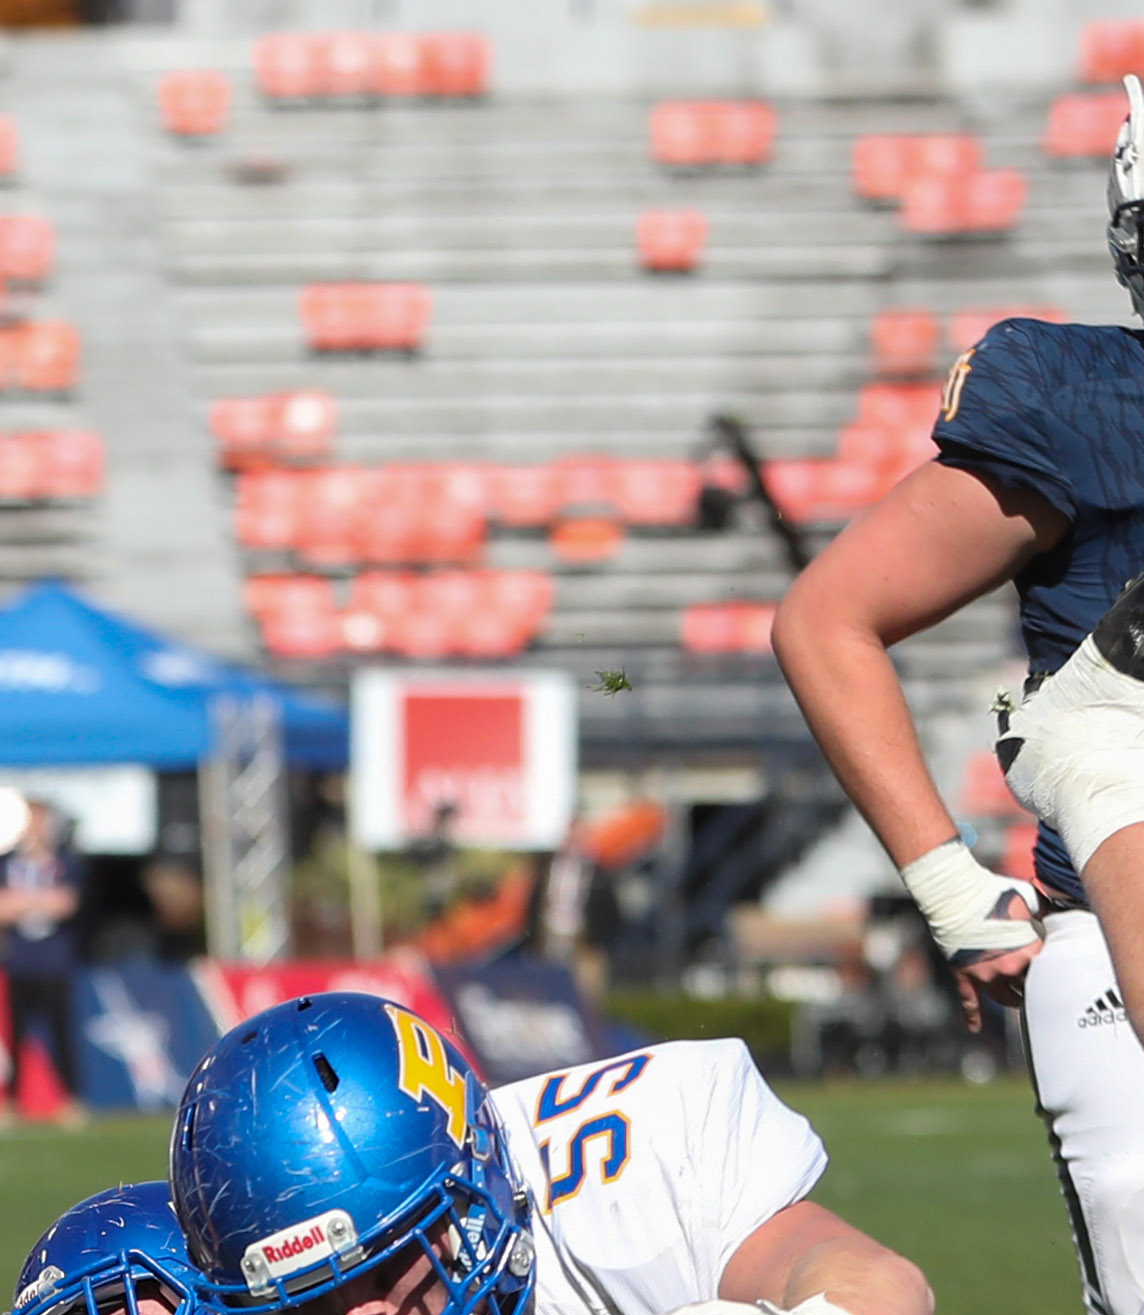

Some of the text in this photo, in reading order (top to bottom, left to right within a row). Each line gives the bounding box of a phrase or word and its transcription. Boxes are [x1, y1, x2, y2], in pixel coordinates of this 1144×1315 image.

[1078, 1005, 1127, 1029] adida
[384, 1004, 467, 1150] P
[533, 1053, 655, 1215] 55
[262, 1226, 326, 1264] Riddell
